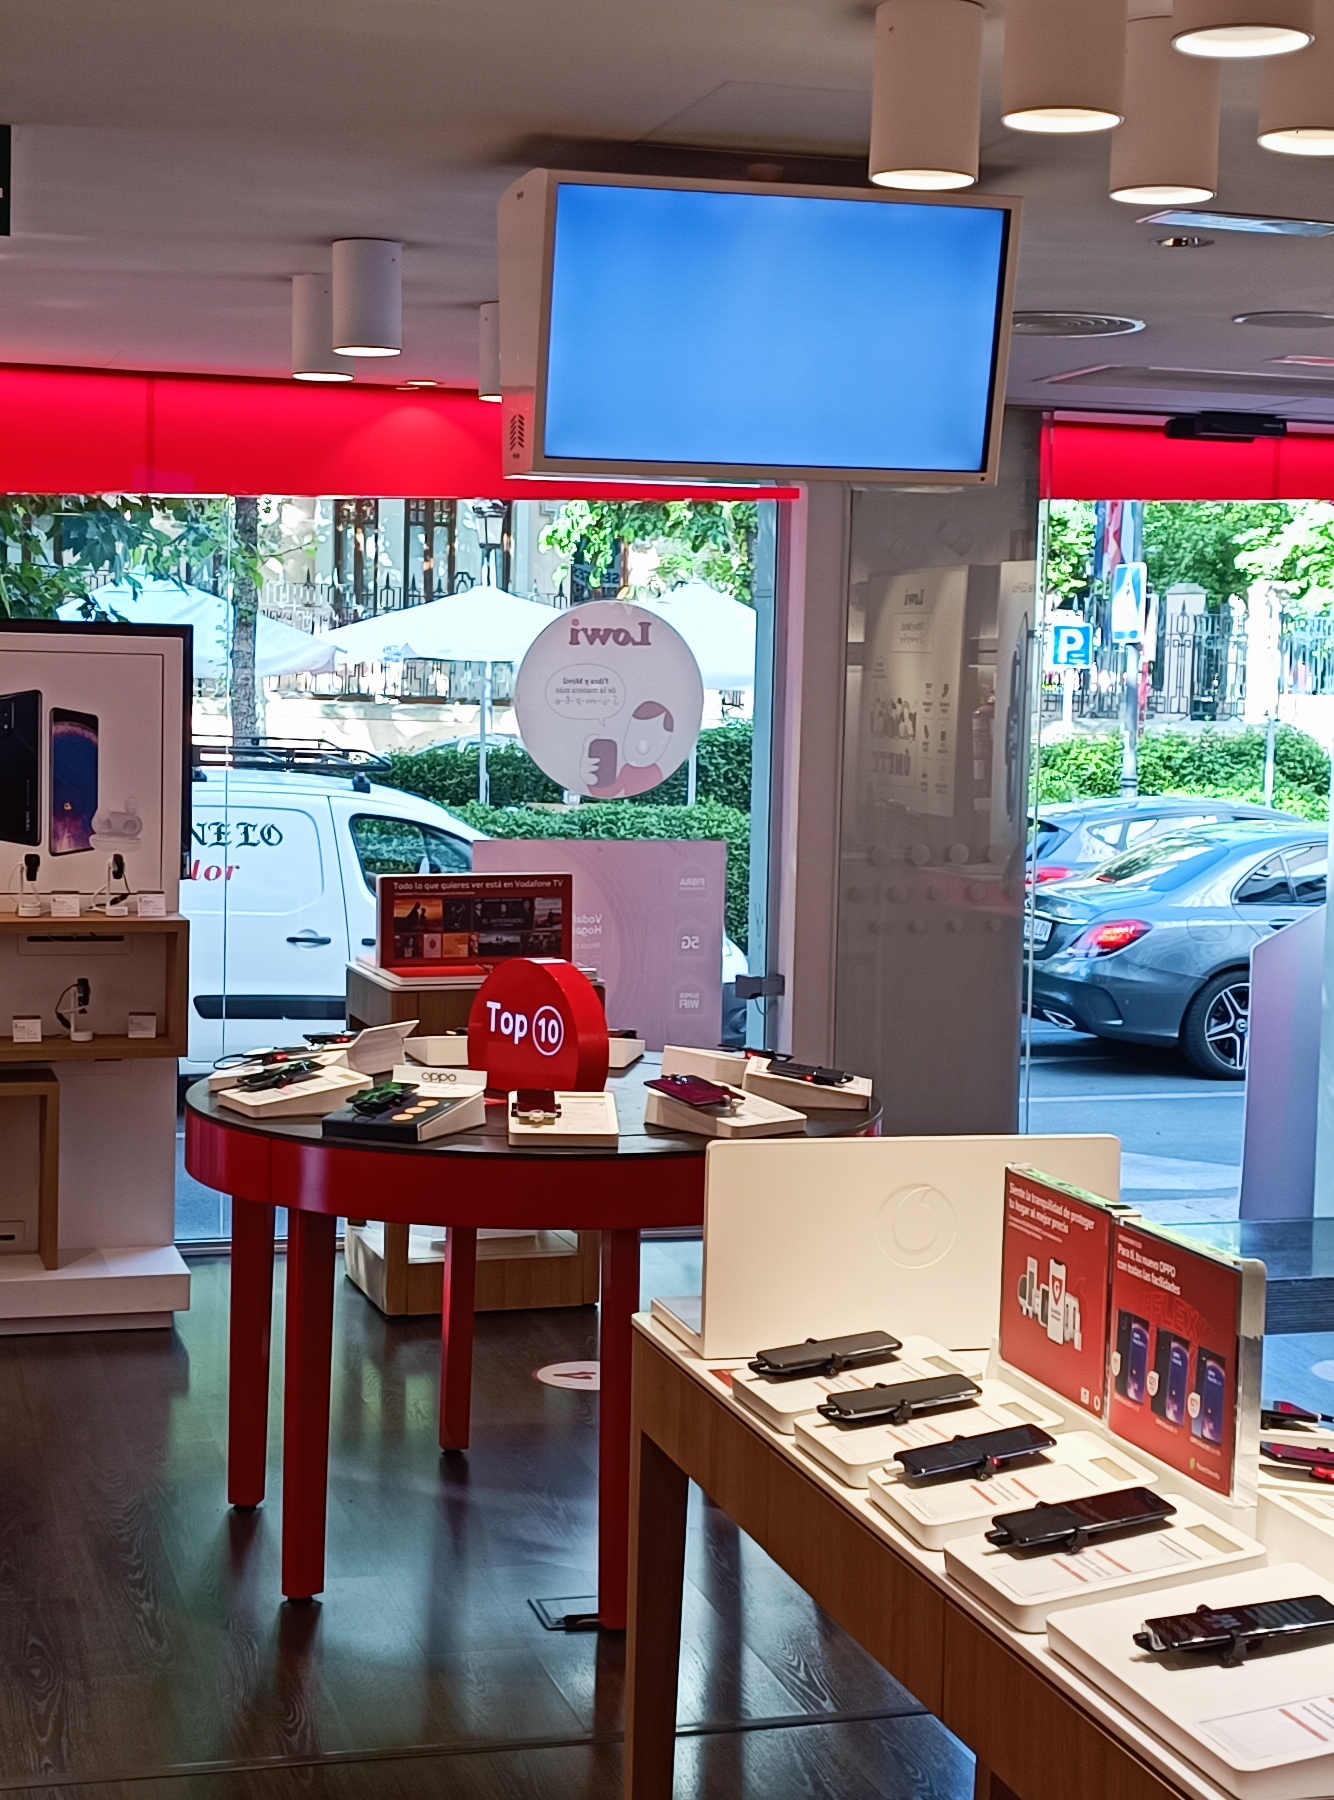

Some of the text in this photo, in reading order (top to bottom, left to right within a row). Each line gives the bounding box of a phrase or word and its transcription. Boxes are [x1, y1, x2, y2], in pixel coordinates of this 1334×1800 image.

[1057, 628, 1085, 664] P
[393, 882, 413, 890] Todo
[415, 882, 423, 890] lo
[424, 883, 439, 891] que
[441, 882, 470, 890] quieres
[485, 881, 502, 889] está
[515, 880, 552, 888] Vodafone
[553, 879, 564, 887] TV
[486, 1001, 559, 1045] Top 10
[421, 1072, 457, 1083] oppo
